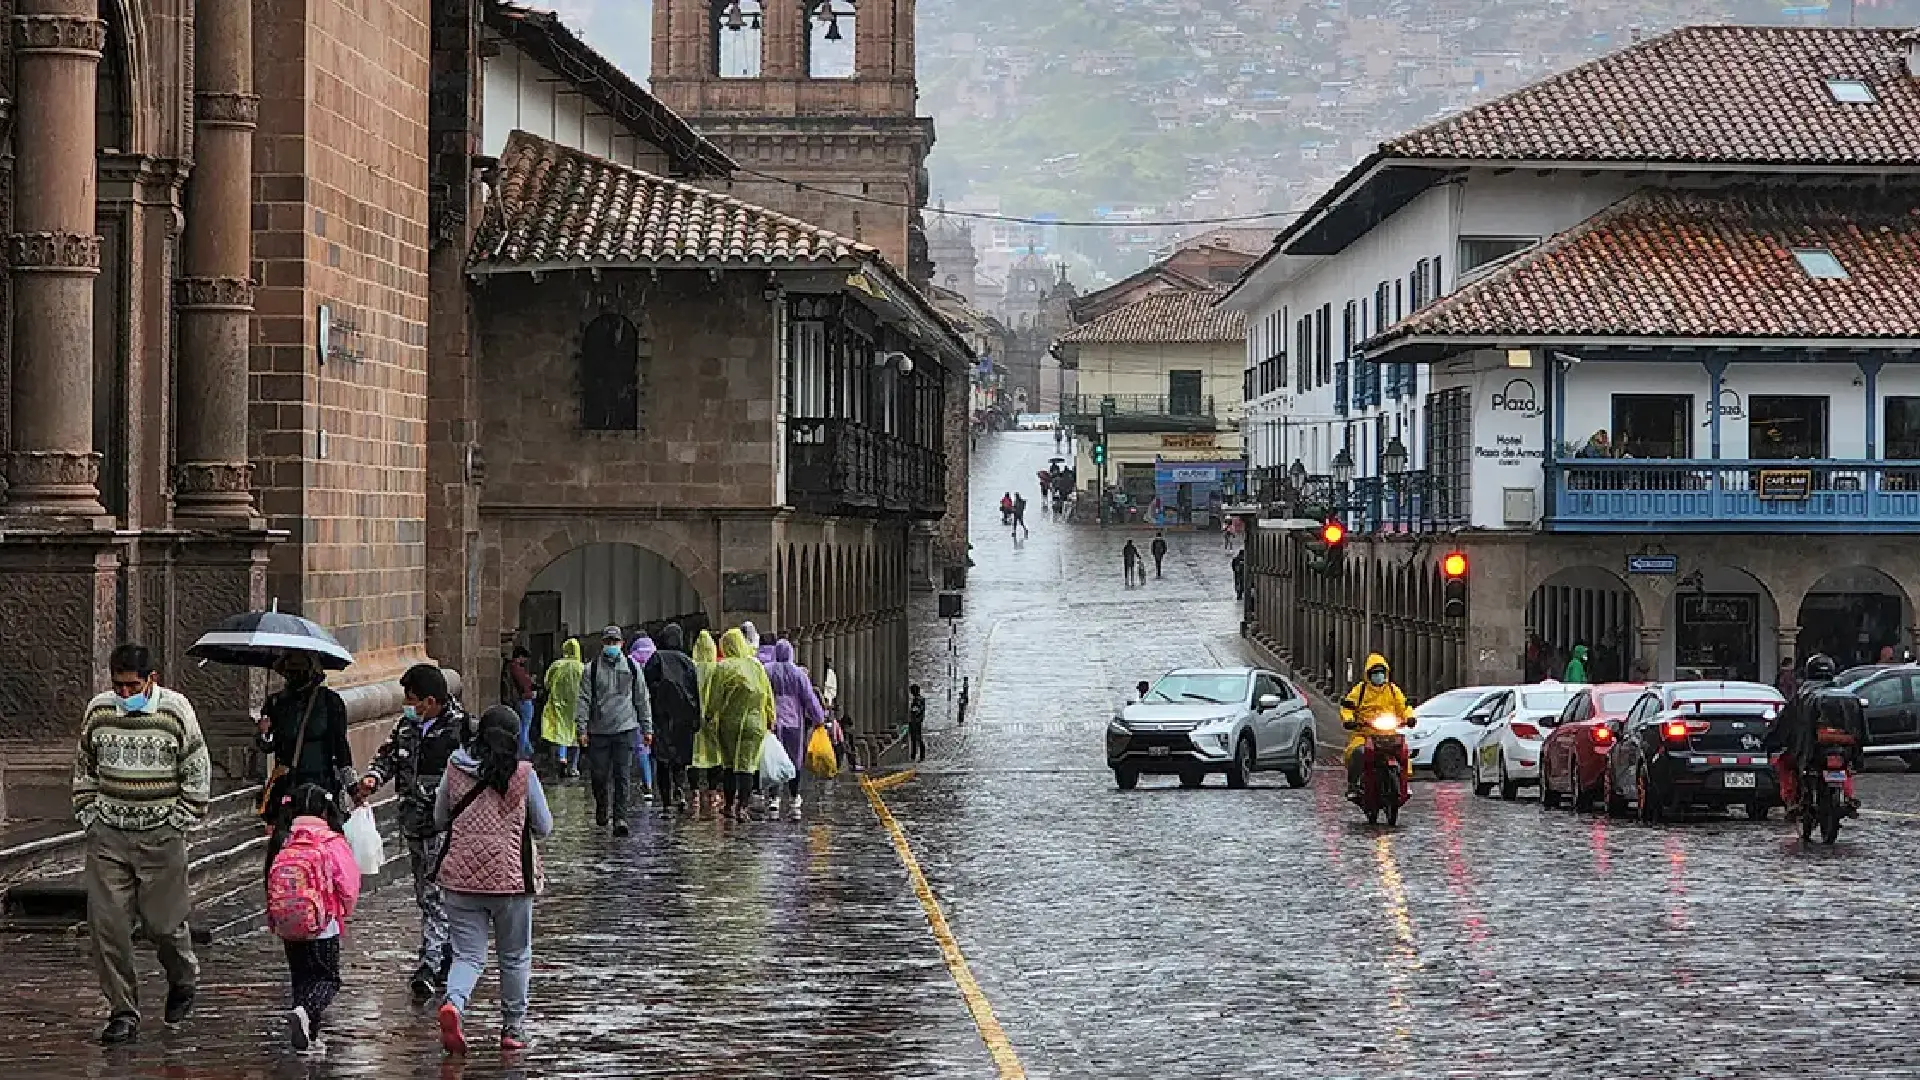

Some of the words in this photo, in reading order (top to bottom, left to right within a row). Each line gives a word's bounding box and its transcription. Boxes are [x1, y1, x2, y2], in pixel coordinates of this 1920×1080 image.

[1491, 379, 1536, 410] Plaza
[1496, 435, 1523, 445] Hotel
[1475, 447, 1500, 457] Plaza
[1502, 447, 1515, 457] de
